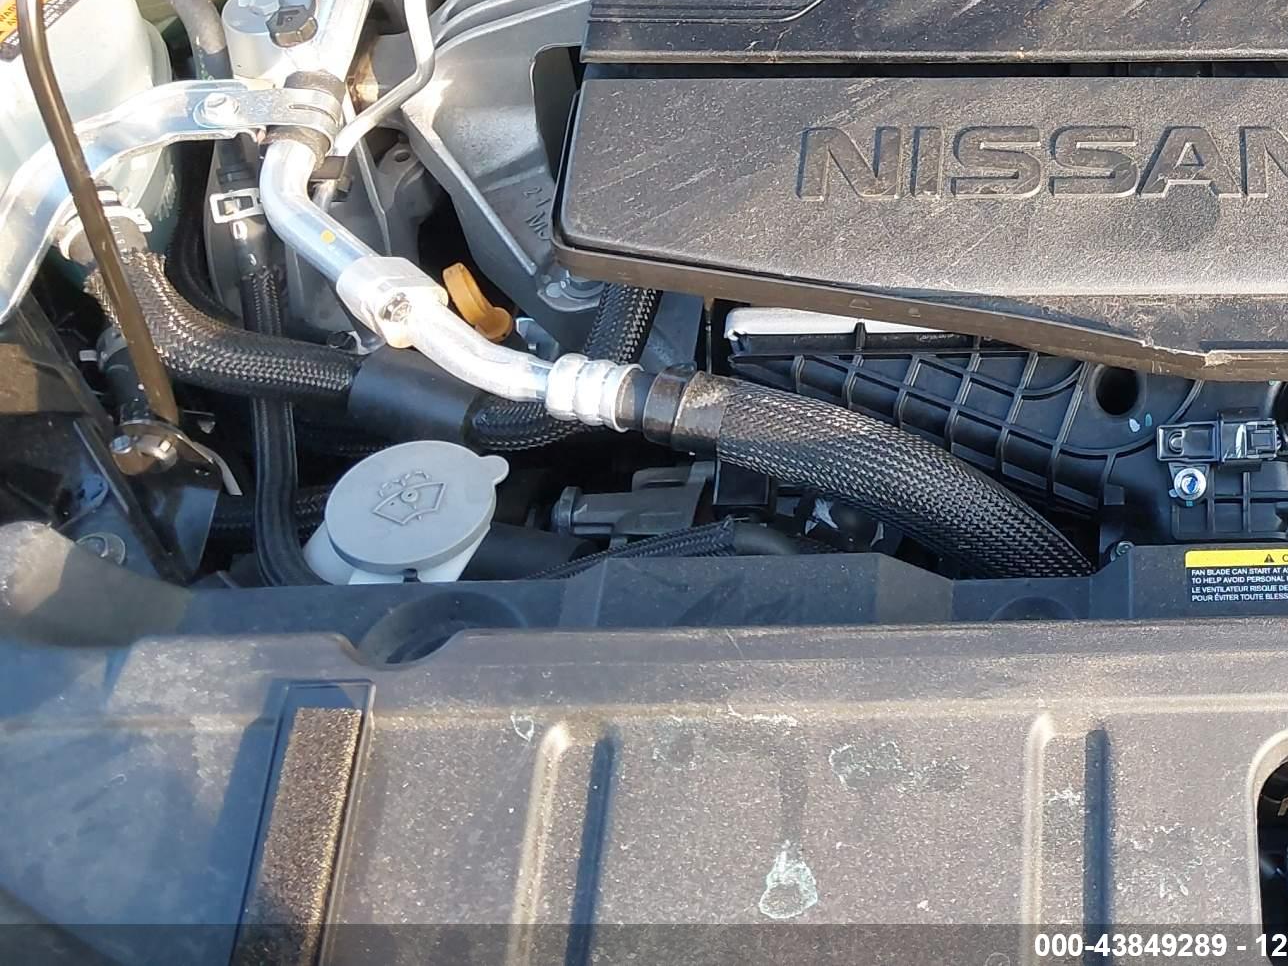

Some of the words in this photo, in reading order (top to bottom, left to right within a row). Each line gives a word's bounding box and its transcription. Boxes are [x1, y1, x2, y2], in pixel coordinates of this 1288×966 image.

[1206, 568, 1231, 576] BLADE
[1249, 567, 1271, 575] START
[1223, 576, 1245, 584] AVOID
[1246, 575, 1286, 583] PERSONAL
[1191, 586, 1201, 594] LE
[1202, 585, 1249, 593] VENTILATEUR
[1191, 594, 1213, 602] POUR
[1214, 592, 1239, 601] ÉVITER
[1240, 593, 1264, 601] TOUTE
